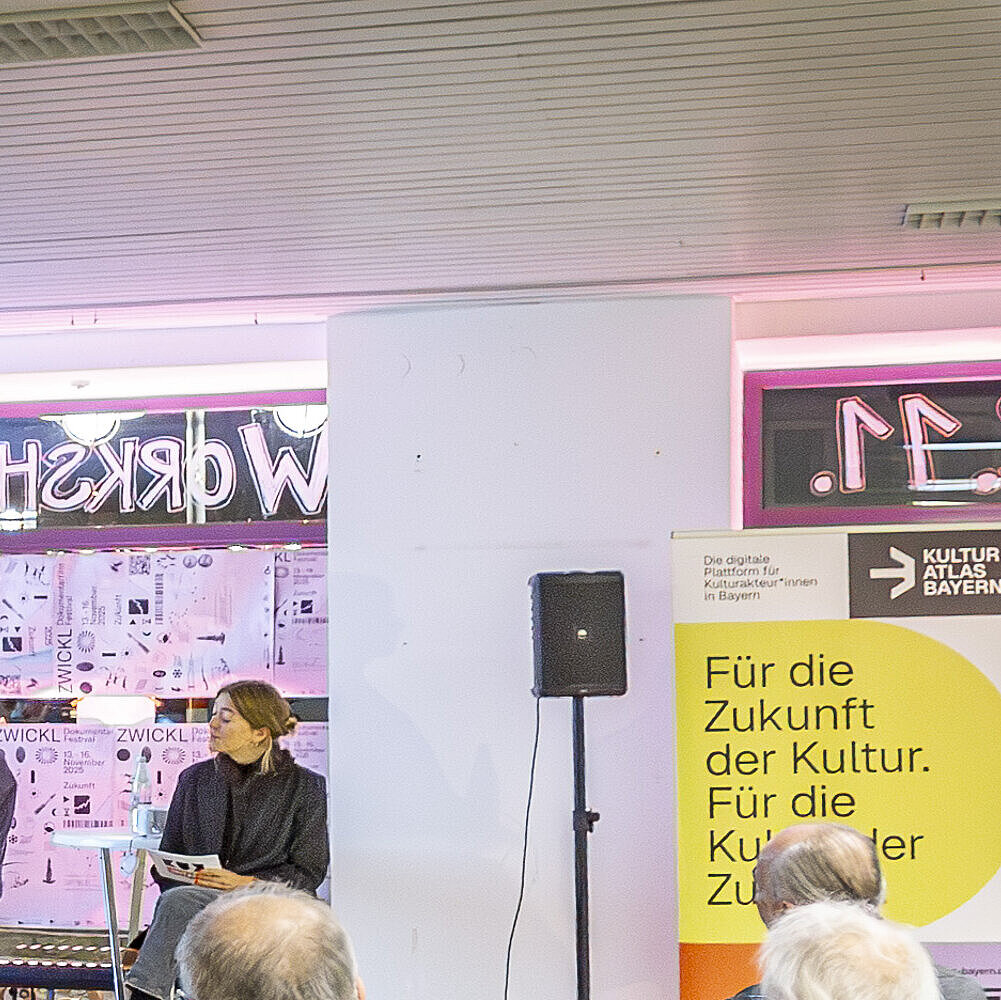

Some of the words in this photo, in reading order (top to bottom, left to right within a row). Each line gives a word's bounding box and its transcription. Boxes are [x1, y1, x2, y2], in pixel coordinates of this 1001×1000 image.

[703, 555, 723, 566] Die
[726, 554, 770, 566] digitale
[923, 546, 1000, 564] KULTUR
[703, 567, 760, 577] Plattform
[923, 563, 987, 580] ATLAS
[703, 591, 715, 601] in
[719, 590, 761, 602] Bayern
[923, 578, 1001, 596] BAYERN
[57, 628, 73, 694] ZWICKL
[705, 655, 776, 689] Für
[789, 653, 854, 687] die
[704, 697, 875, 732] Zukunft
[117, 728, 189, 742] ZWICKL
[706, 743, 777, 776] der
[792, 741, 930, 775] Kultur.
[63, 766, 84, 774] 2025
[708, 785, 777, 819] Für
[791, 784, 856, 818] die
